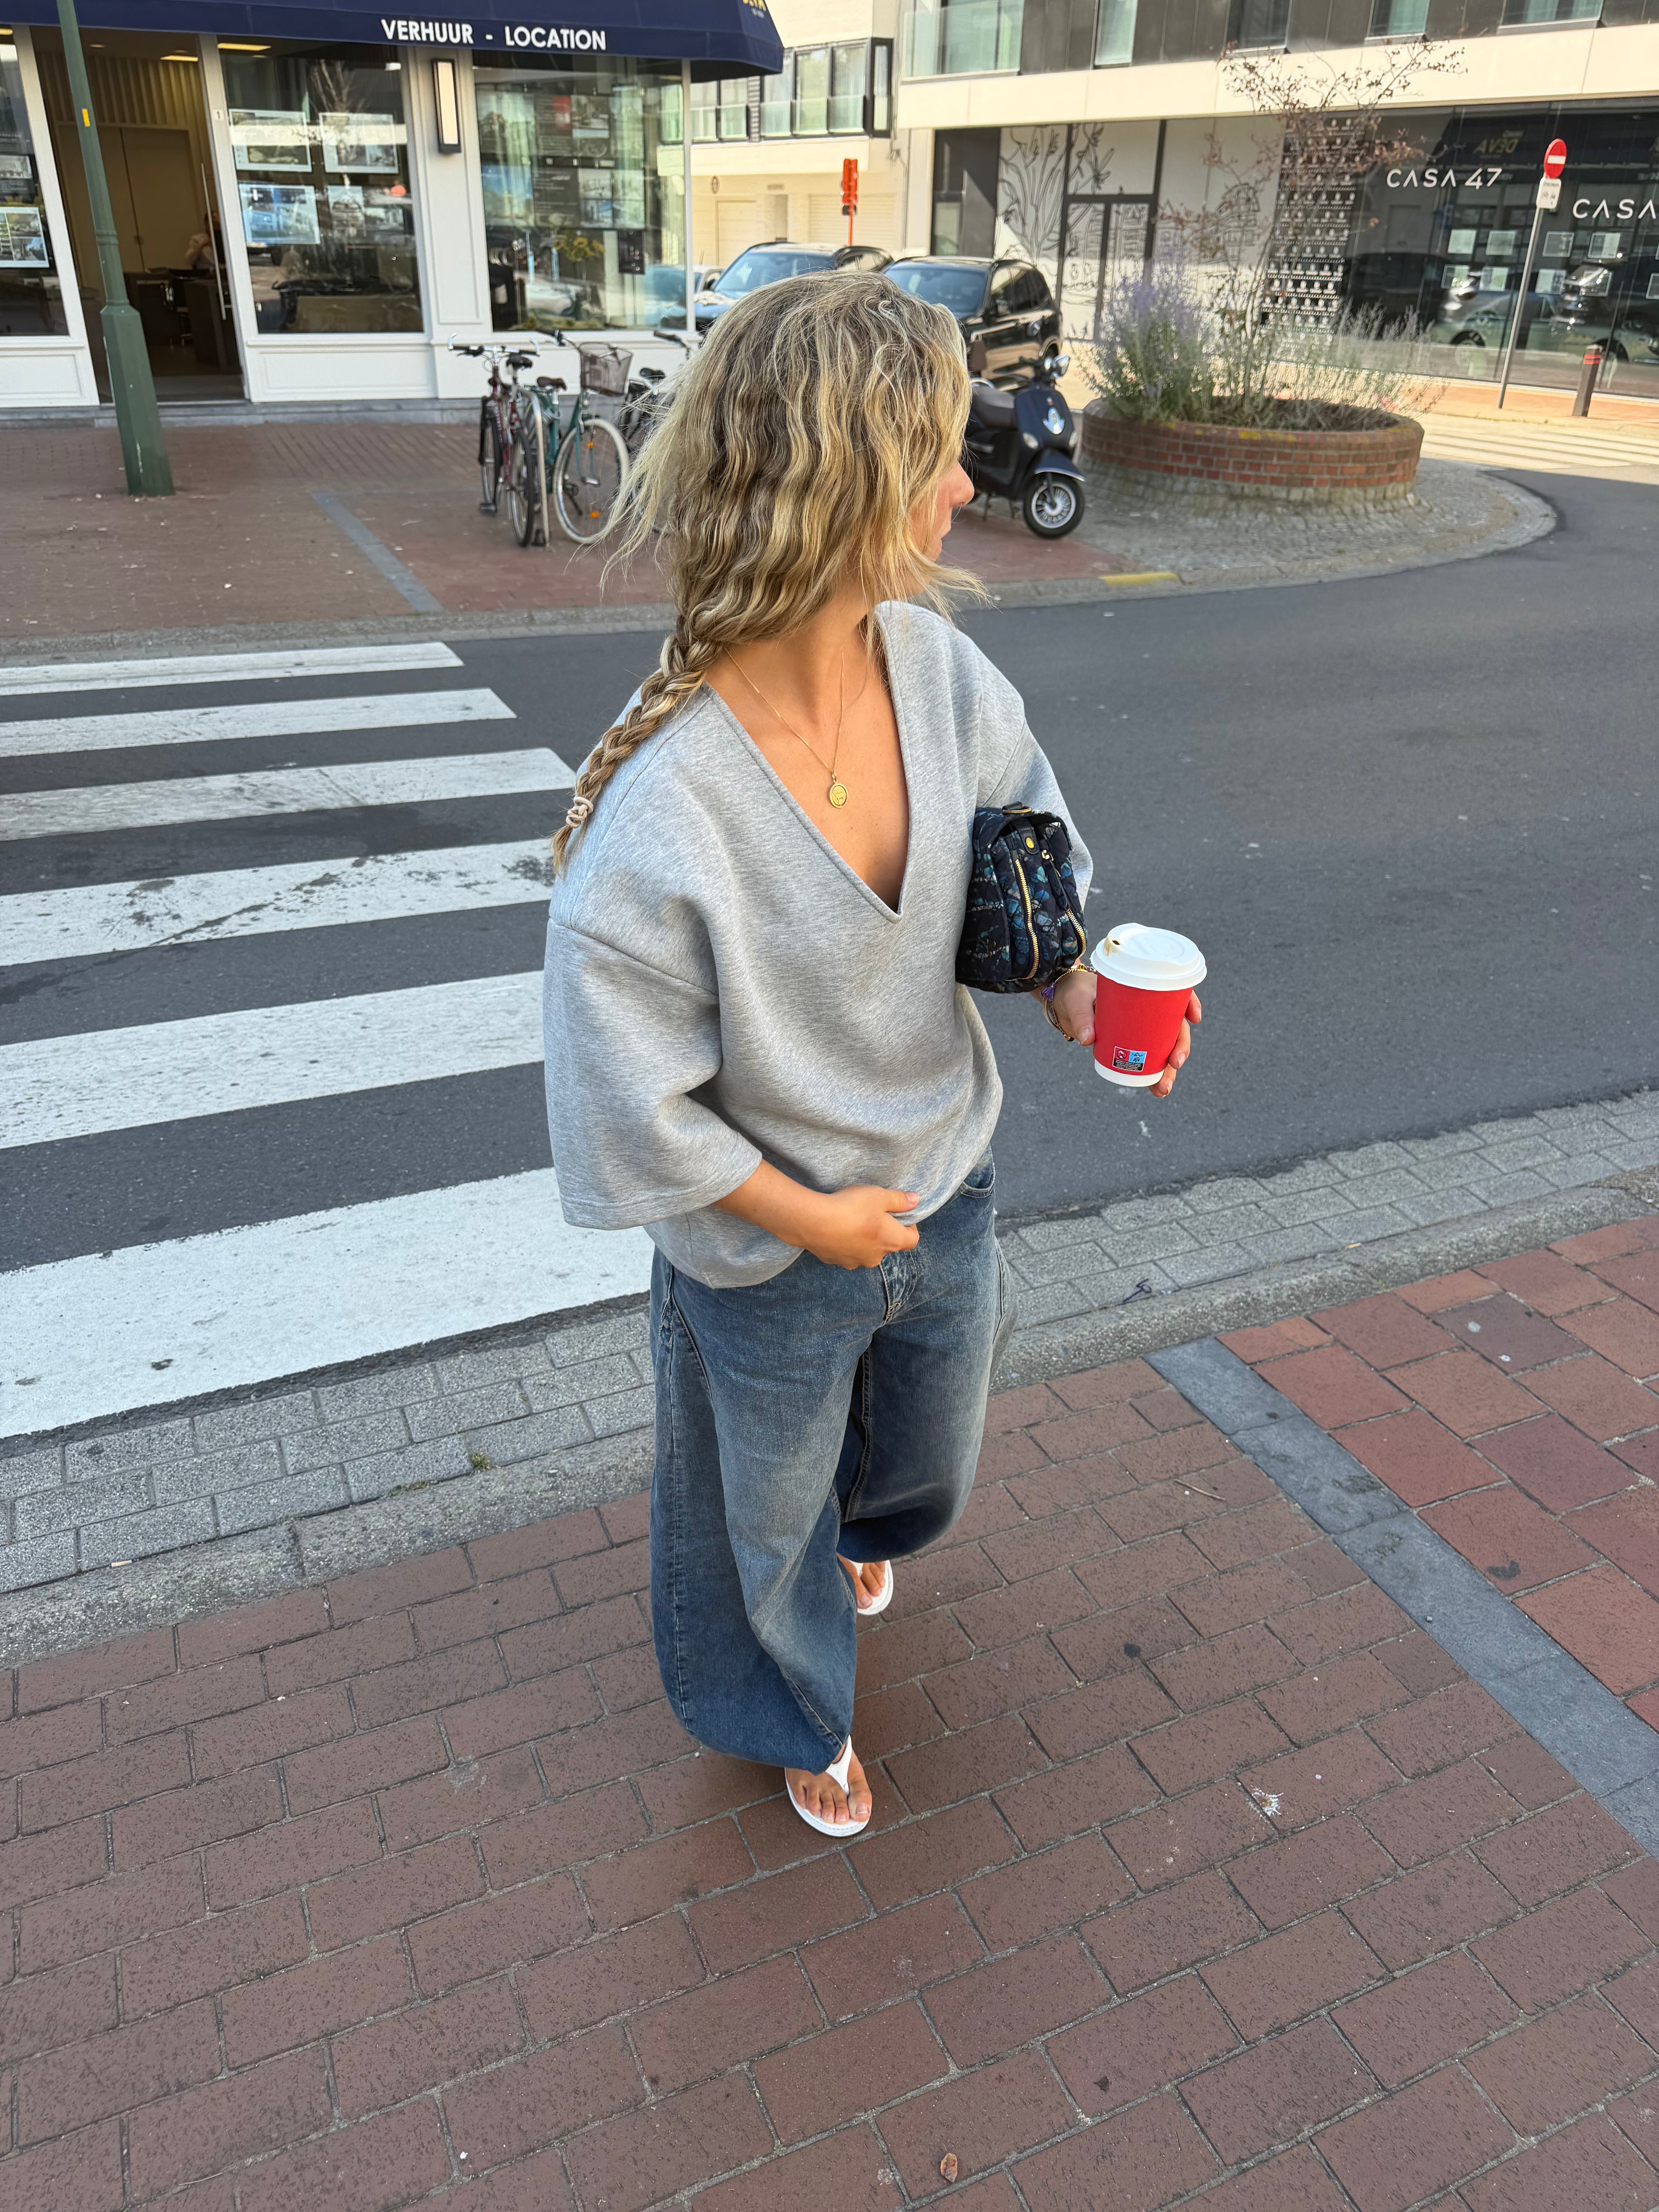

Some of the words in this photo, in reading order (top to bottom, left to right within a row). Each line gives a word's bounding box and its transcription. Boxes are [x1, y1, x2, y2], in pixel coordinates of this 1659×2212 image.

[381, 19, 474, 44] VERHUUR
[505, 26, 606, 50] LOCATION
[1387, 168, 1456, 187] CASA
[1465, 168, 1503, 190] 47
[1572, 199, 1656, 219] CASA
